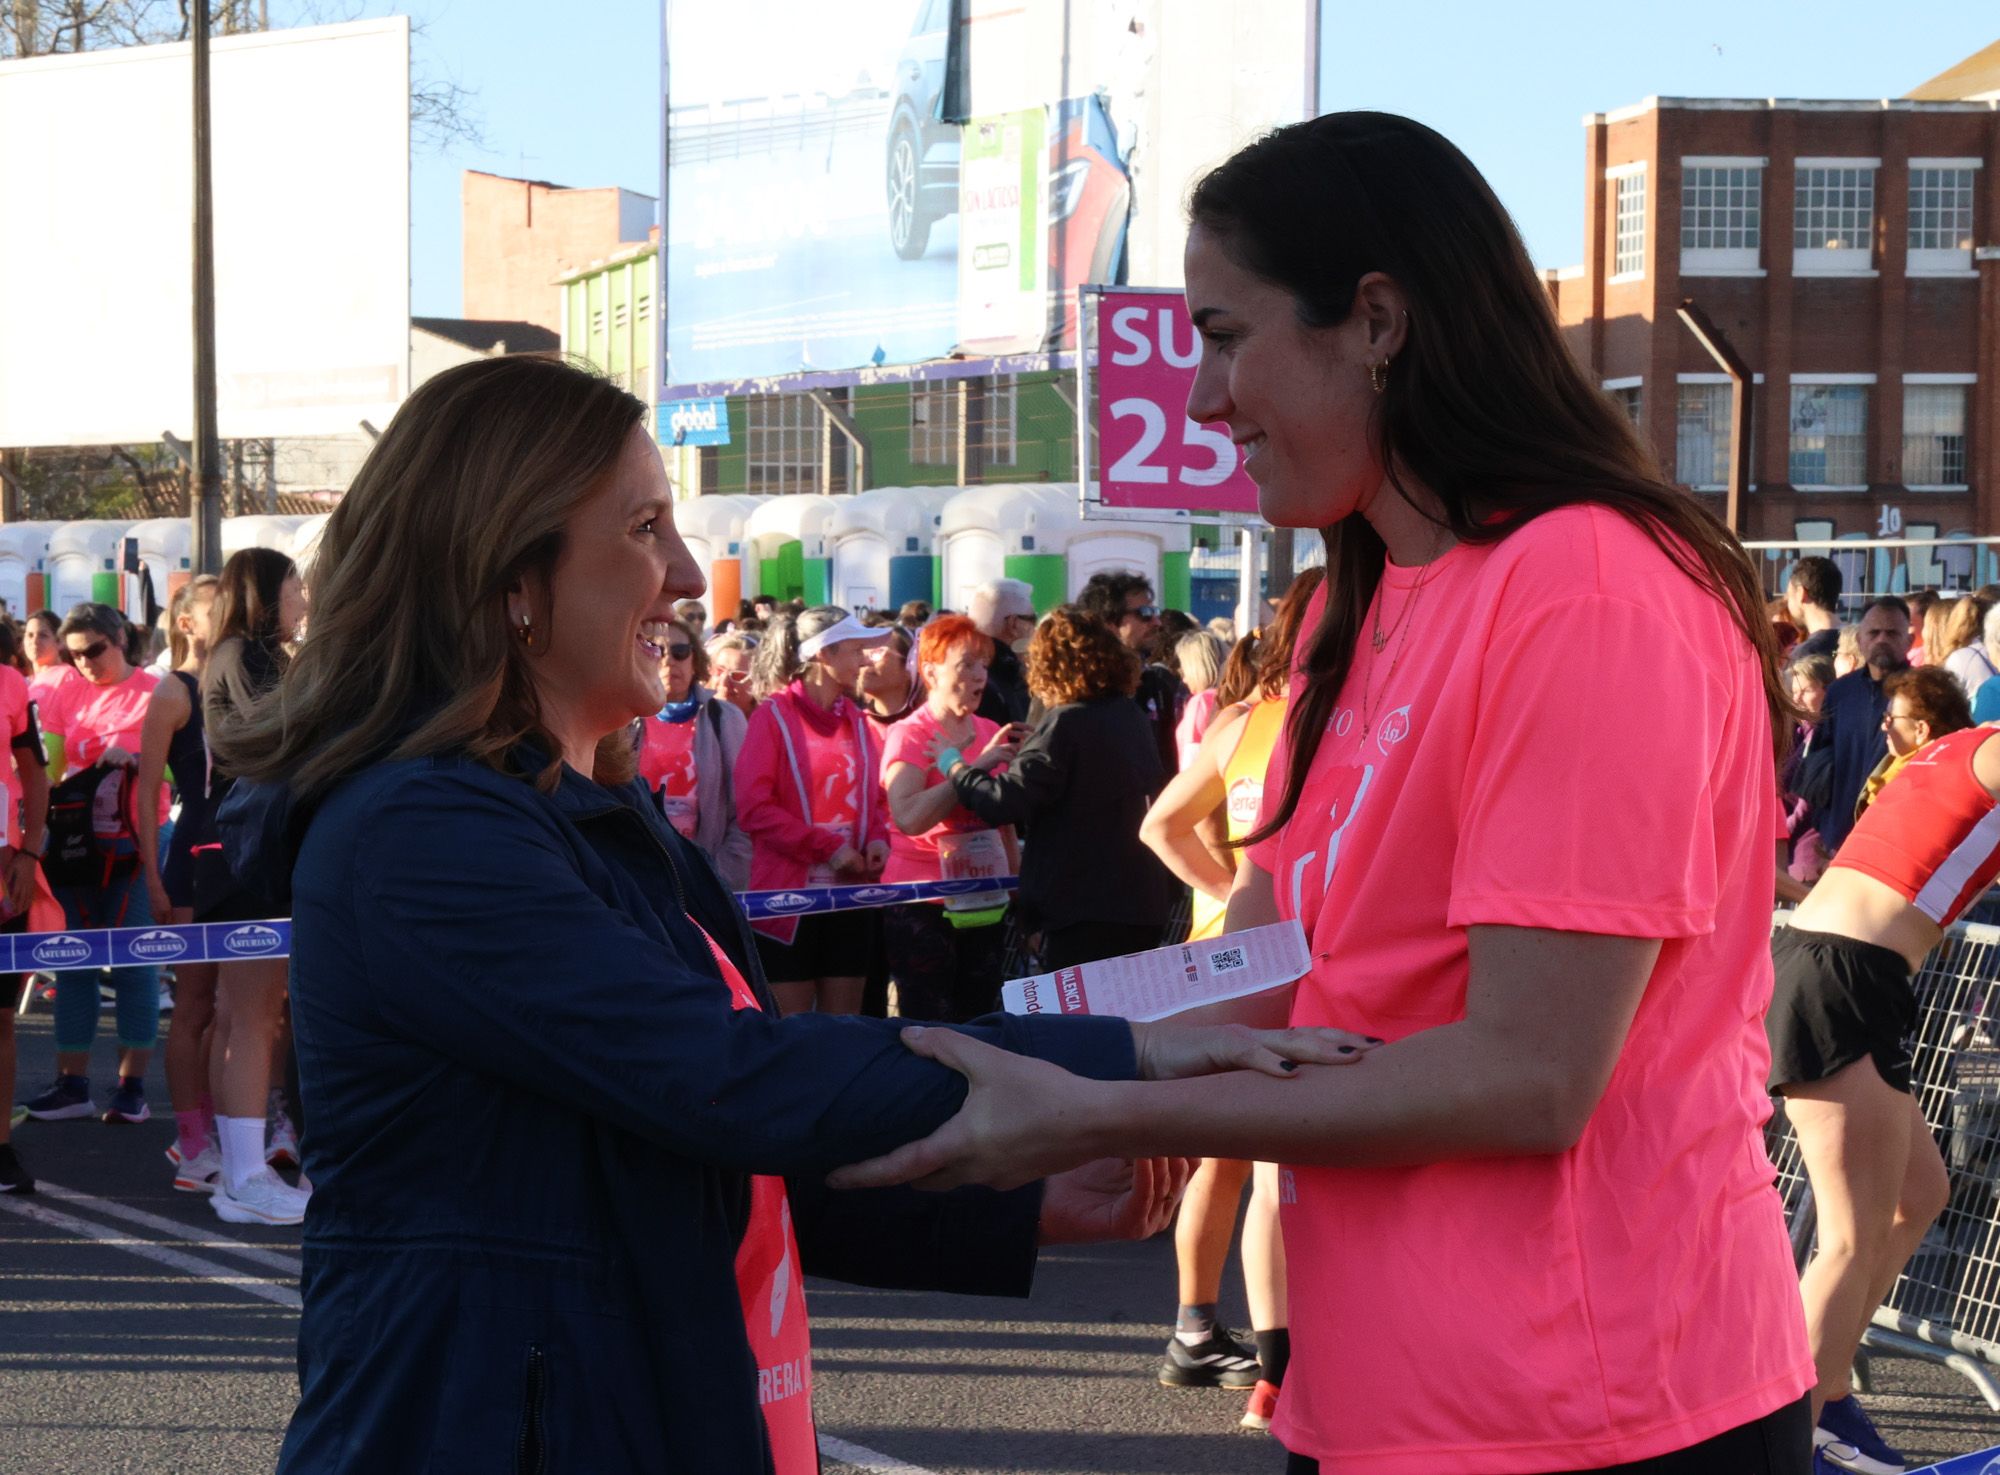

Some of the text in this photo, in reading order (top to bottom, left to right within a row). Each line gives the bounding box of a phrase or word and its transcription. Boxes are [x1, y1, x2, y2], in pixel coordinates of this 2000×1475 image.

[671, 401, 717, 438] global
[1108, 397, 1238, 487] 25
[38, 948, 88, 958] ASTURIANA
[134, 942, 183, 953] ASTURIANA
[230, 937, 277, 948] ASTURIANA
[1023, 980, 1043, 1015] ntand
[758, 1359, 802, 1405] RERA
